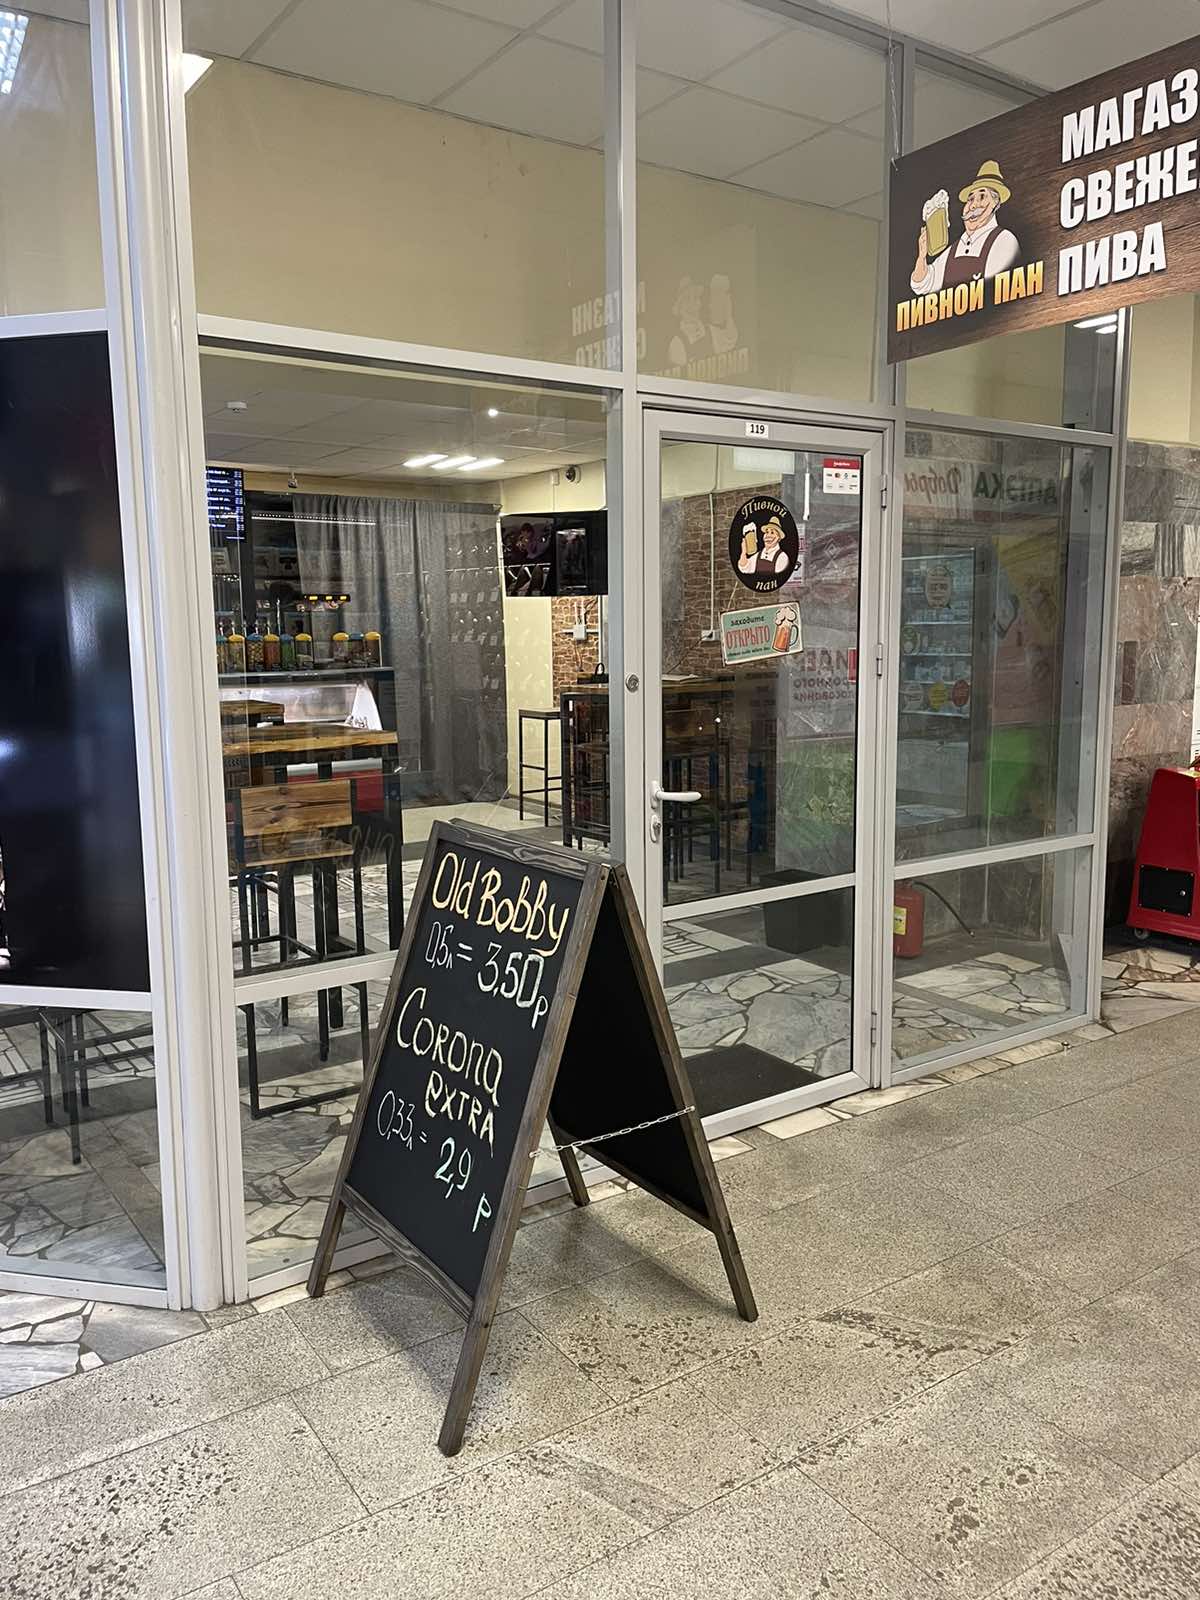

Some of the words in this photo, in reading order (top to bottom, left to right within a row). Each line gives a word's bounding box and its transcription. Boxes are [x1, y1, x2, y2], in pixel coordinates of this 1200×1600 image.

[1061, 68, 1199, 163] МАГАЗ
[1060, 139, 1199, 229] СВЕЖЕ
[1057, 221, 1167, 297] ПИВА
[896, 274, 984, 332] ПИВНОЙ
[994, 261, 1044, 305] ПАН
[750, 424, 765, 434] 119
[741, 499, 788, 520] Пивной
[755, 579, 778, 591] пан
[726, 625, 771, 649] ОТКРЫТО
[730, 615, 765, 627] заходите
[432, 852, 480, 919] Old
[434, 1137, 472, 1199] 2,9
